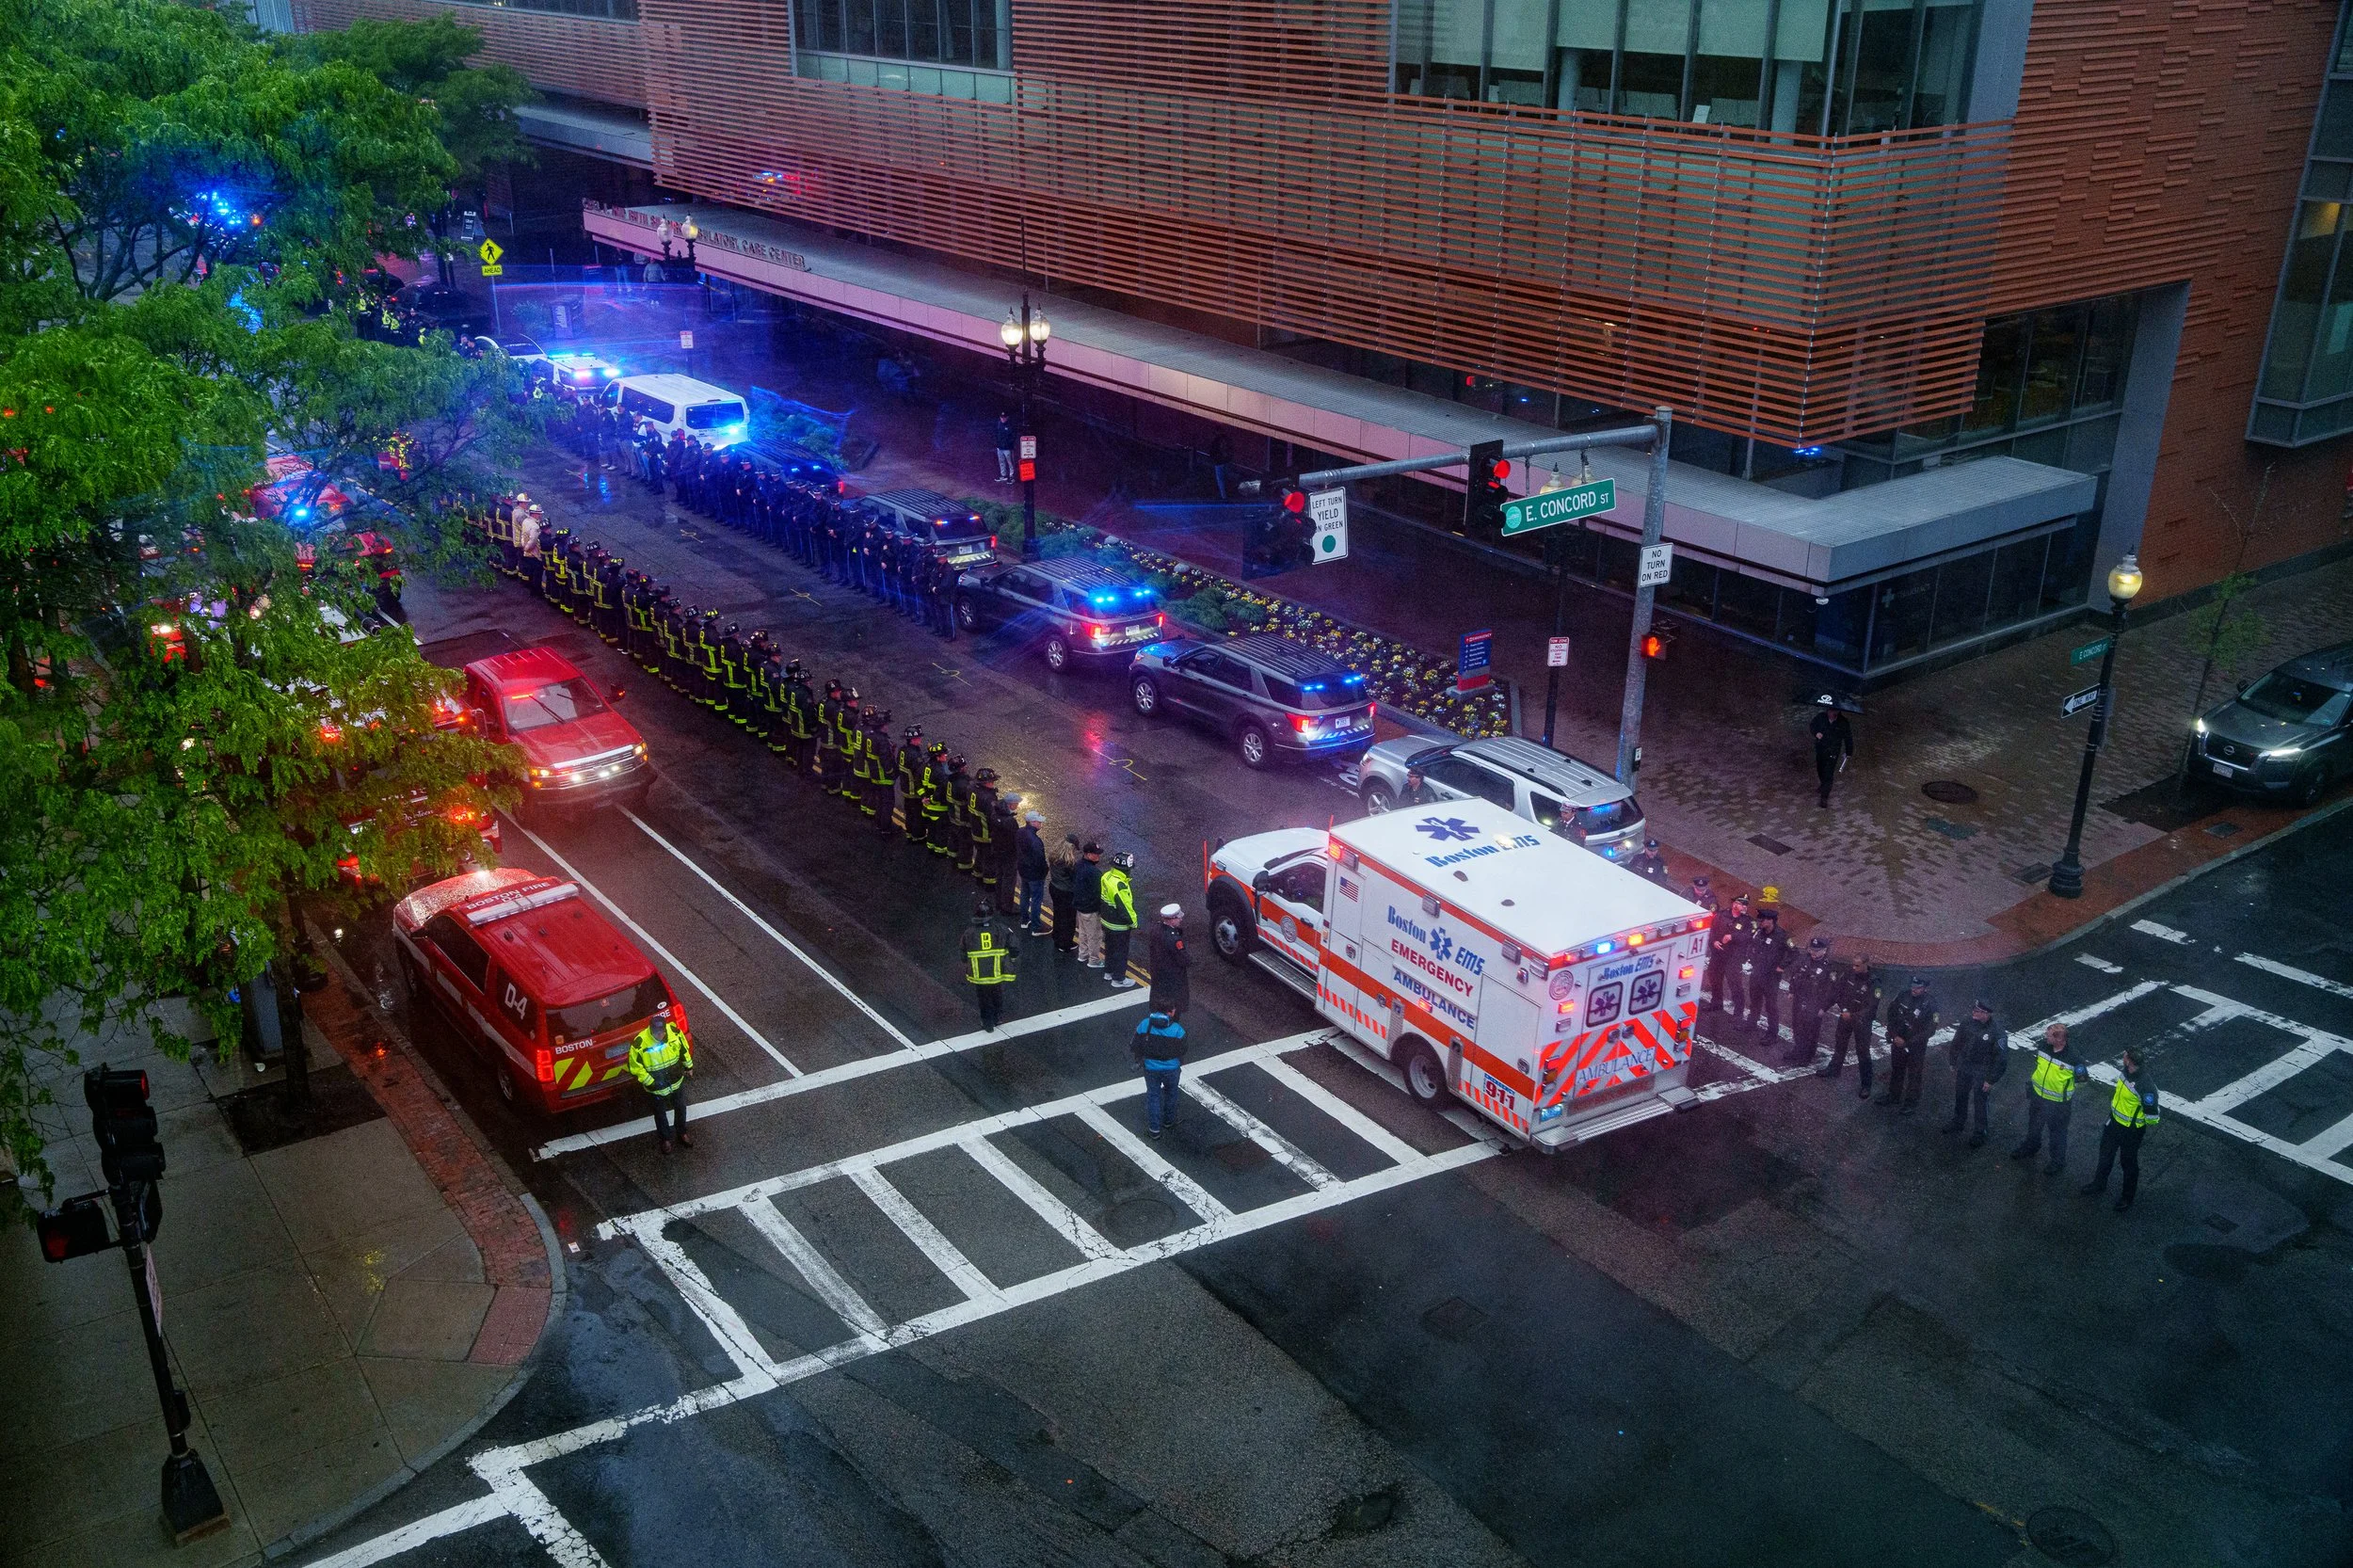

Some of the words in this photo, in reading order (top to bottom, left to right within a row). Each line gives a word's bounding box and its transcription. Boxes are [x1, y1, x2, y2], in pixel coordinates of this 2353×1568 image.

[768, 247, 806, 269] CENTER
[484, 266, 501, 275] AHEAD
[1312, 499, 1326, 509] LEFT
[1328, 496, 1342, 506] TURN
[1526, 505, 1537, 522] E.
[1540, 491, 1596, 519] CONCORD
[1600, 492, 1609, 504] ST
[1318, 508, 1338, 520] YIELD
[1324, 520, 1344, 532] GREEN
[1647, 559, 1666, 569] TURN
[1652, 550, 1662, 558] NO
[1641, 573, 1652, 582] ON
[1654, 569, 1668, 580] RED
[2073, 696, 2083, 708] ONE
[2085, 691, 2097, 702] WAY
[1424, 845, 1501, 868] Boston
[467, 889, 520, 910] BOSTON
[521, 882, 551, 892] FIRE
[1387, 904, 1426, 944] Boston
[1454, 946, 1485, 976] EMS
[1690, 936, 1705, 955] A1
[1391, 937, 1474, 998] EMERGENCY
[1603, 964, 1634, 981] Boston
[1634, 953, 1657, 973] EMS
[504, 982, 528, 1021] D-4
[1393, 969, 1476, 1031] AMBULANCE
[554, 1038, 593, 1055] BOSTON
[1577, 1048, 1655, 1083] AMBULANCE
